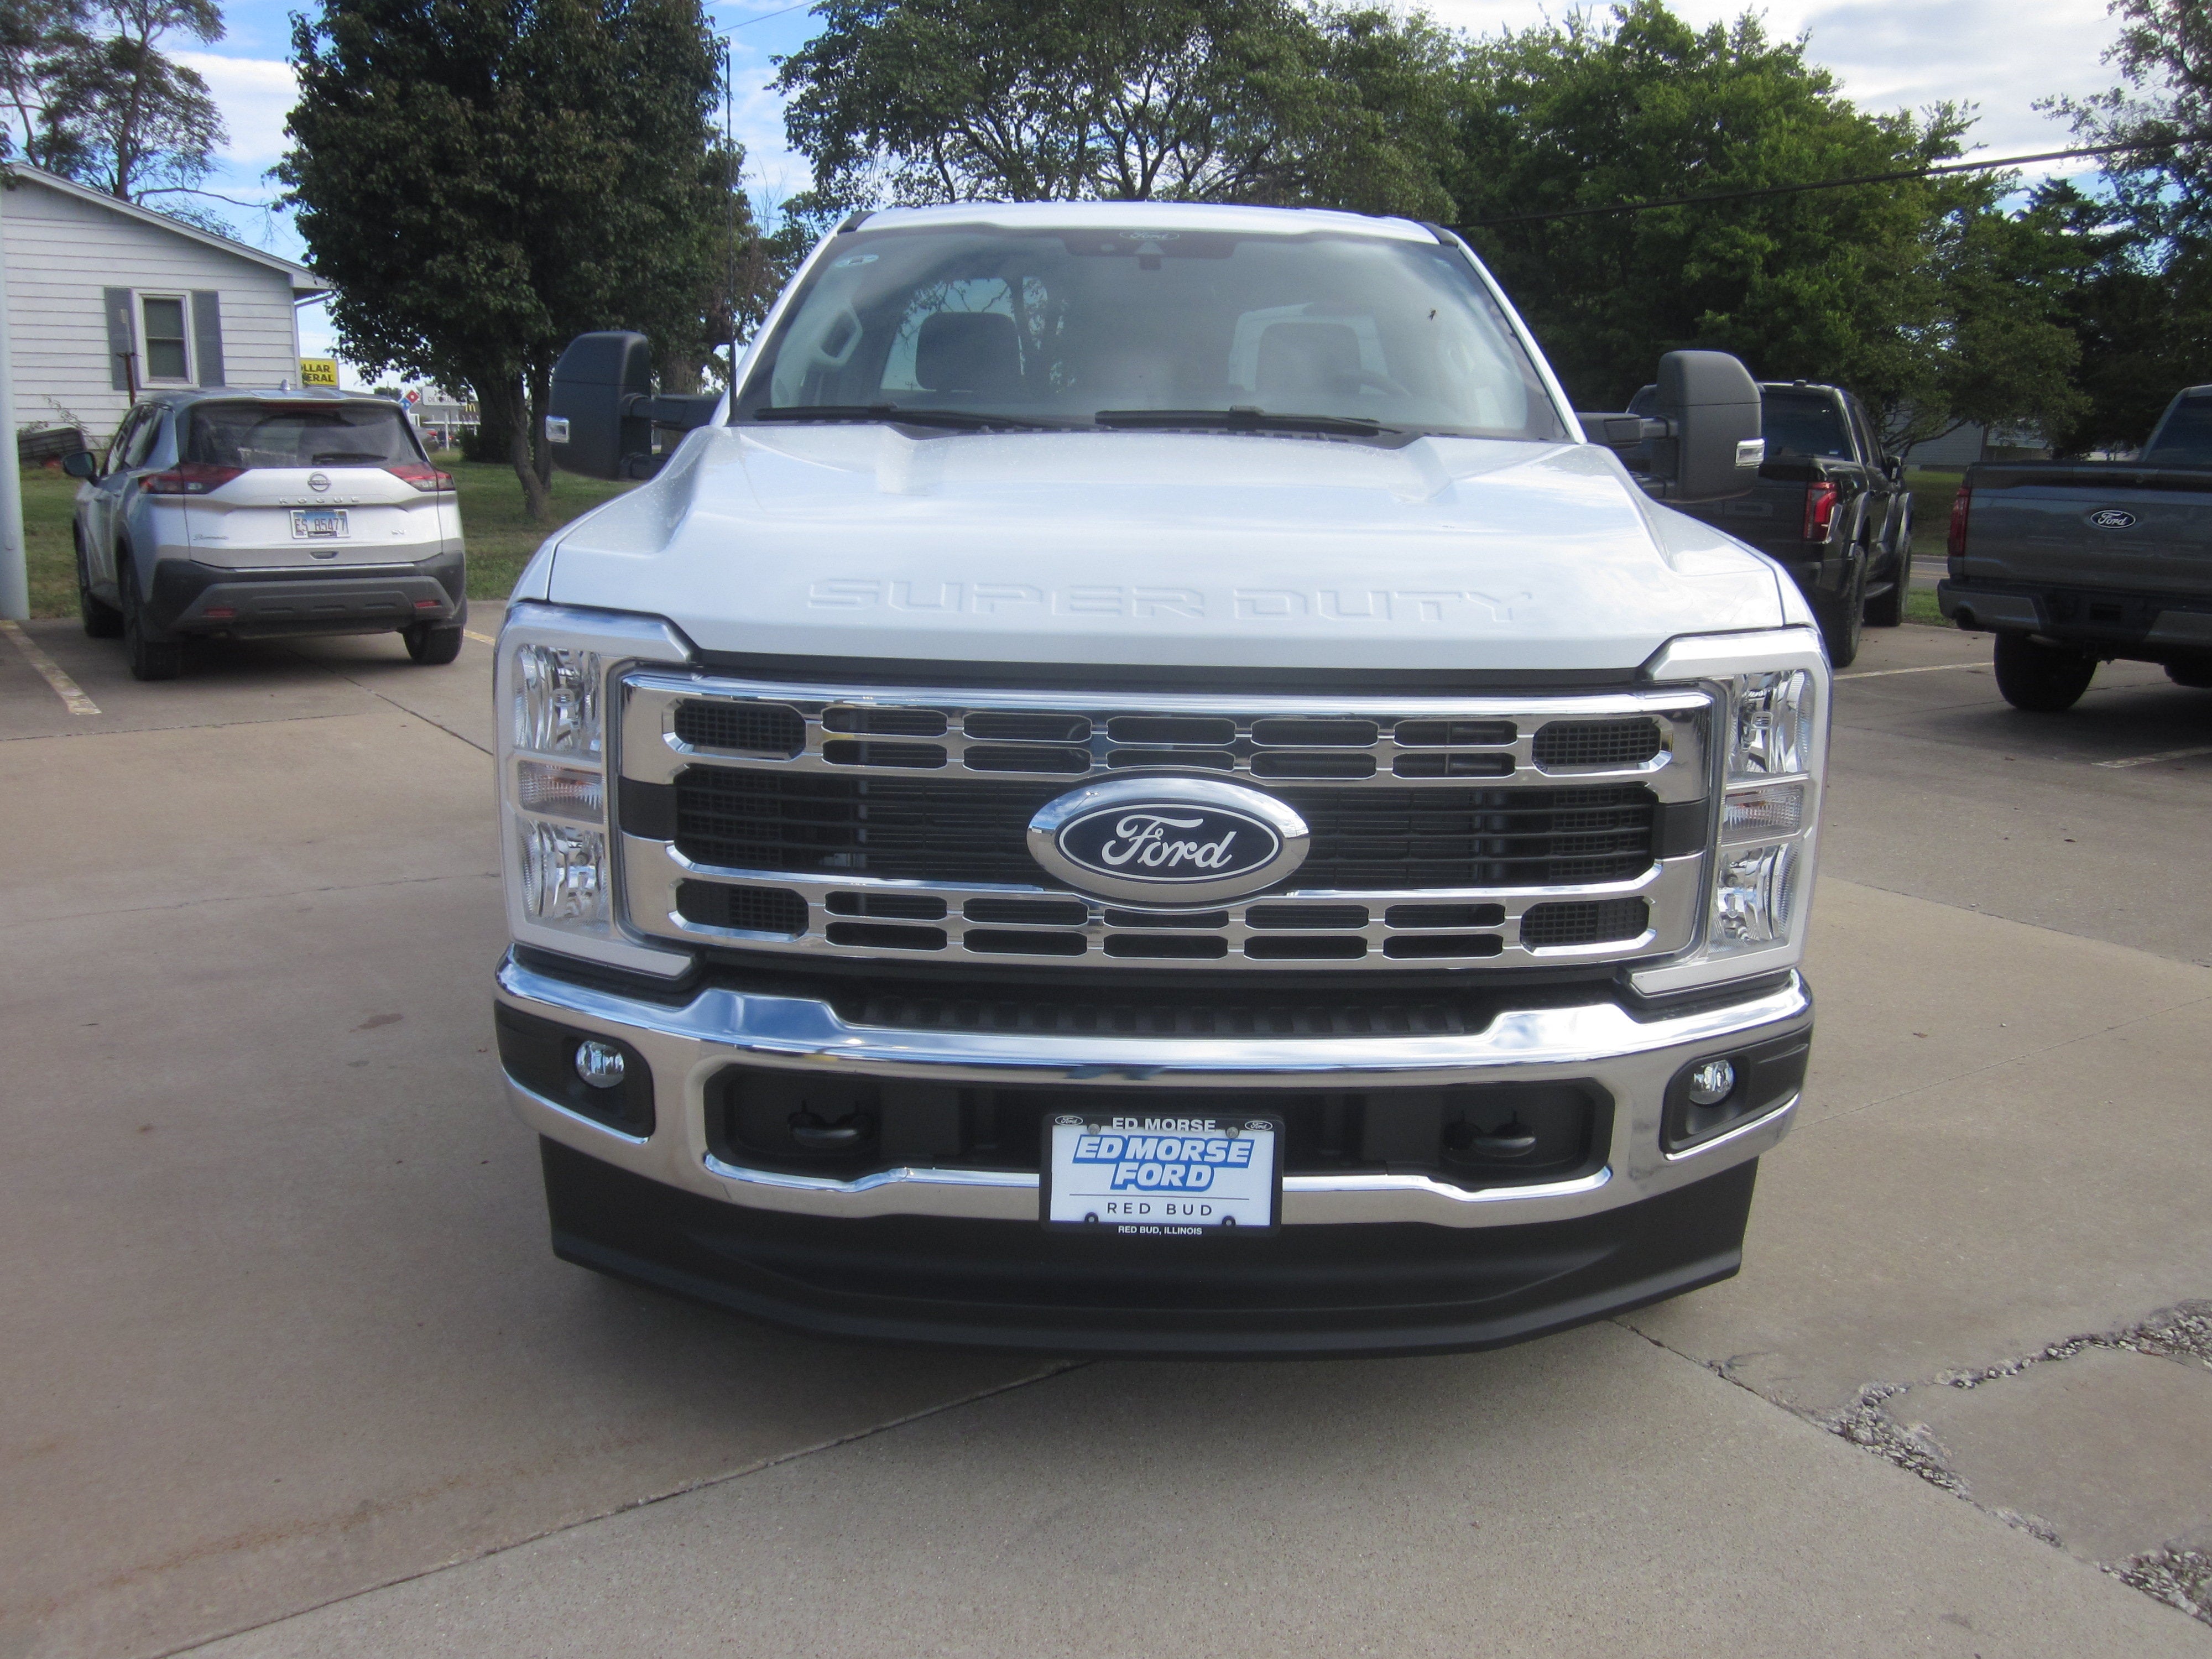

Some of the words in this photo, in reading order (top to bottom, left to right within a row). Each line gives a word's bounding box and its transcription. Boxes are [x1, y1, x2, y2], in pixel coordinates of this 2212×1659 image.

[306, 373, 335, 382] ERAL
[2098, 512, 2127, 525] Ford
[807, 578, 1204, 618] SUPER
[1233, 588, 1533, 622] DUTY
[1101, 814, 1237, 869] Ford
[1112, 1117, 1138, 1130] ED
[1144, 1118, 1217, 1133] MORSE
[1074, 1135, 1123, 1159] ED
[1124, 1136, 1252, 1164] MORSE
[1114, 1162, 1213, 1188] FORD
[1107, 1202, 1151, 1214] RED
[1166, 1203, 1212, 1216] BUD
[1118, 1225, 1138, 1234] RED
[1139, 1226, 1161, 1235] BUD,
[1164, 1227, 1202, 1235] ILLINOIS
